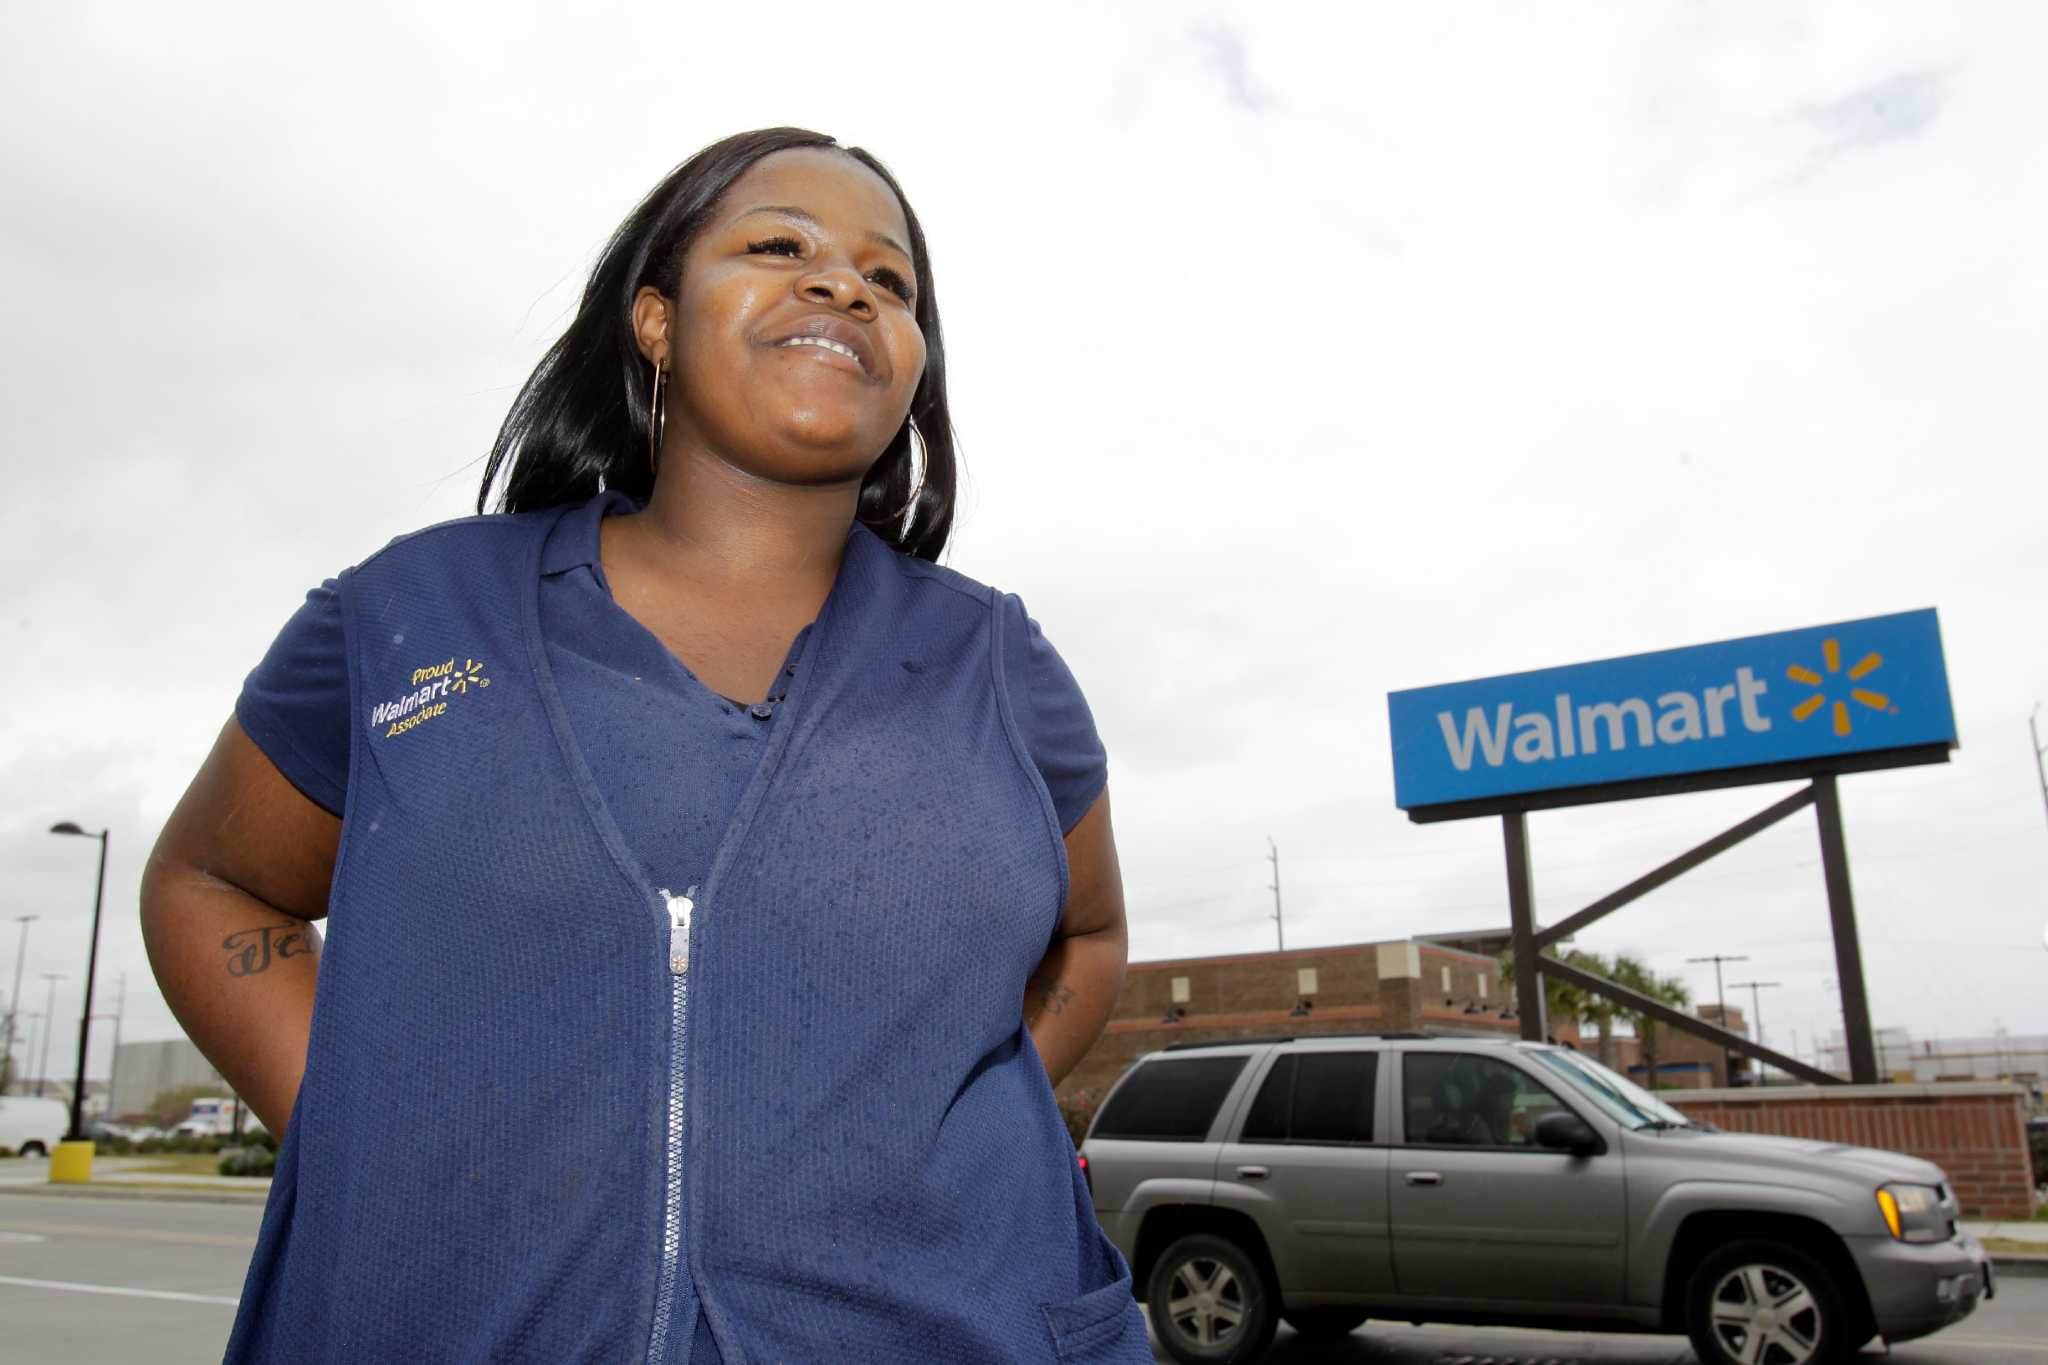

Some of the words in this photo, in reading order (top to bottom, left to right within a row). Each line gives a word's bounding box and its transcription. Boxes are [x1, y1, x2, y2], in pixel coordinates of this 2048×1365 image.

[412, 657, 454, 685] Proud
[372, 676, 451, 727] Walmart
[386, 702, 447, 738] Associate
[1438, 667, 1772, 771] Walmart
